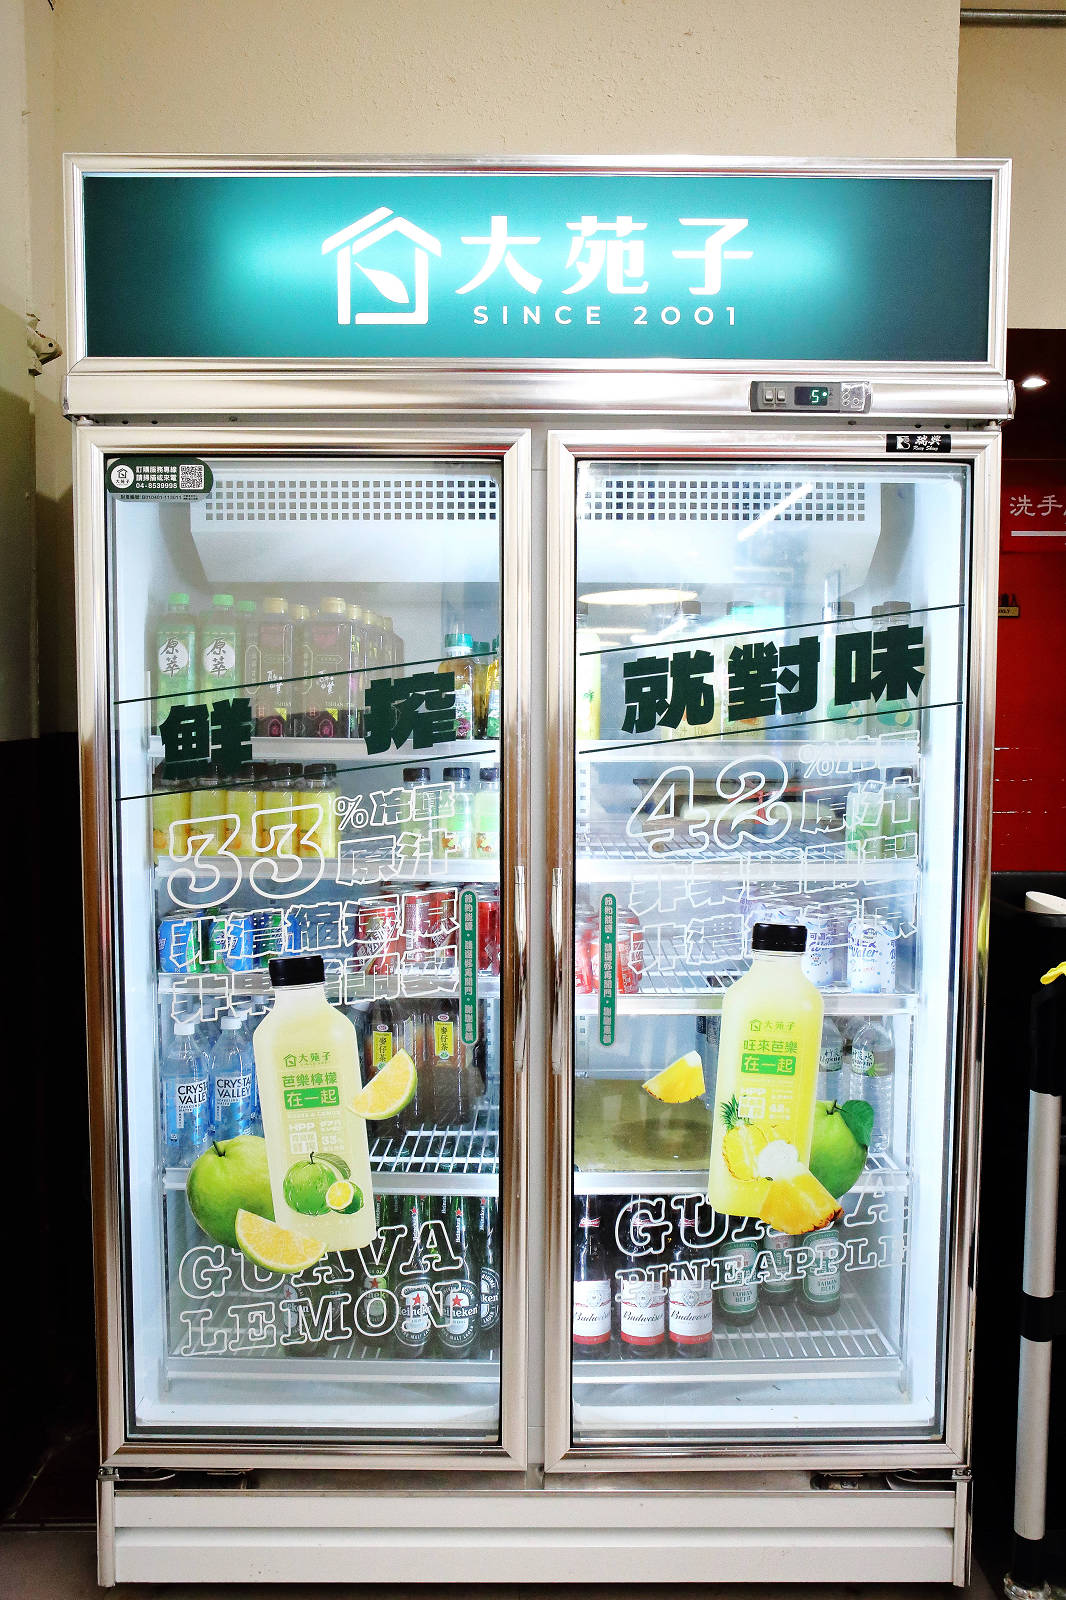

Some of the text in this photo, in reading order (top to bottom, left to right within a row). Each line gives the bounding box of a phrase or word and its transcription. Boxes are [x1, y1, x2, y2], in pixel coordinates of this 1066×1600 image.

[455, 215, 754, 295] 大苑子
[473, 305, 736, 326] SINCE 2001
[1010, 494, 1066, 516] 洗手
[160, 637, 180, 678] 原萃
[206, 637, 228, 679] 原萃
[621, 624, 925, 734] 就對味
[626, 754, 793, 858] 42
[167, 803, 325, 908] 33
[743, 1040, 798, 1053] 旺來芭樂
[744, 1056, 793, 1072] 在一起
[287, 1089, 337, 1107] 在一起
[180, 1280, 463, 1357] LEMON
